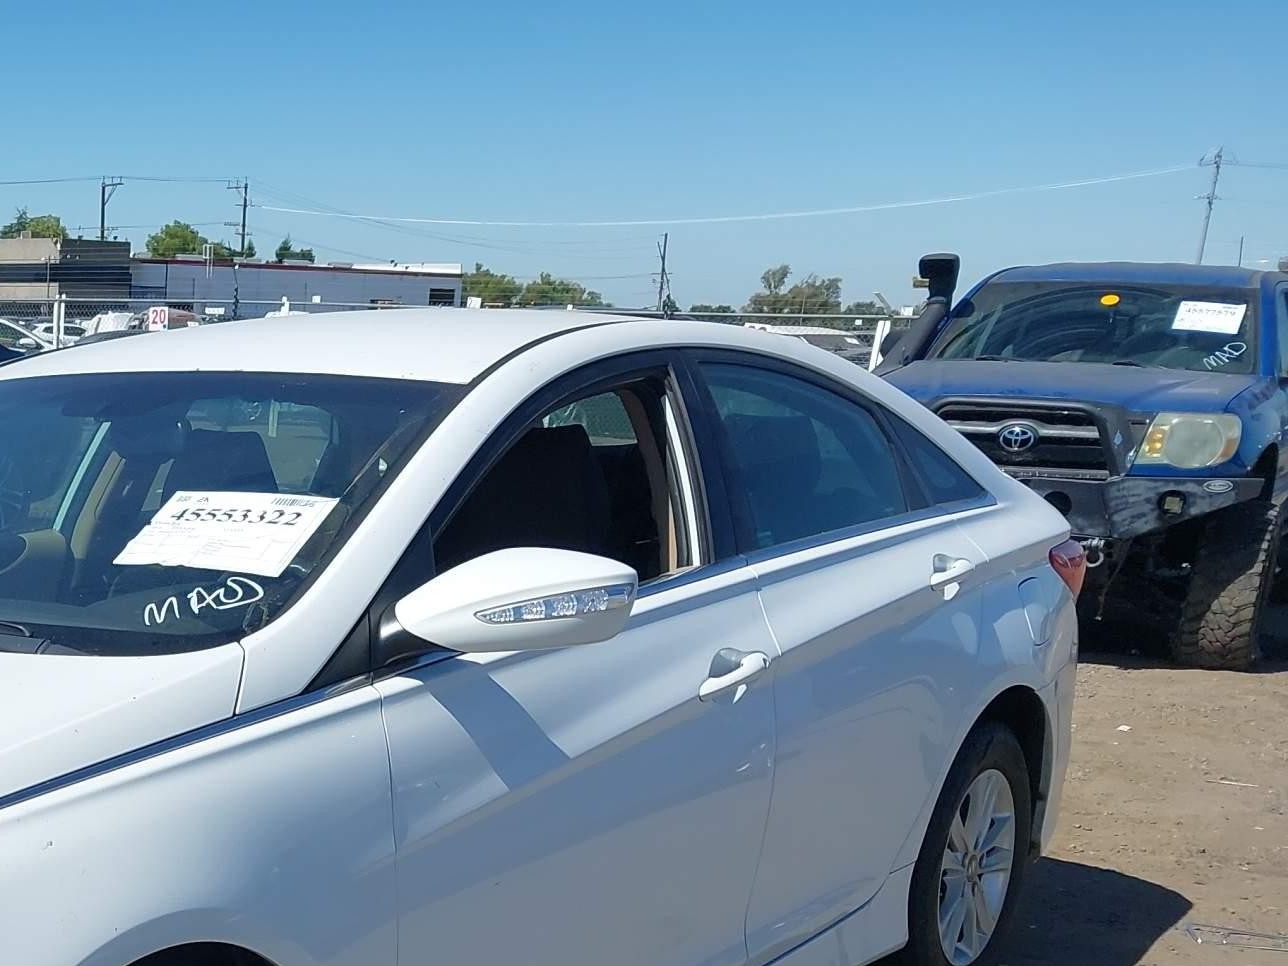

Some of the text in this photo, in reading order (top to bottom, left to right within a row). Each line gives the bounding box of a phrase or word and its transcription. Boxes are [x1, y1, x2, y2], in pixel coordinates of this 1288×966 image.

[151, 309, 166, 325] 20
[1202, 341, 1247, 370] MAD
[170, 508, 303, 527] 45553322
